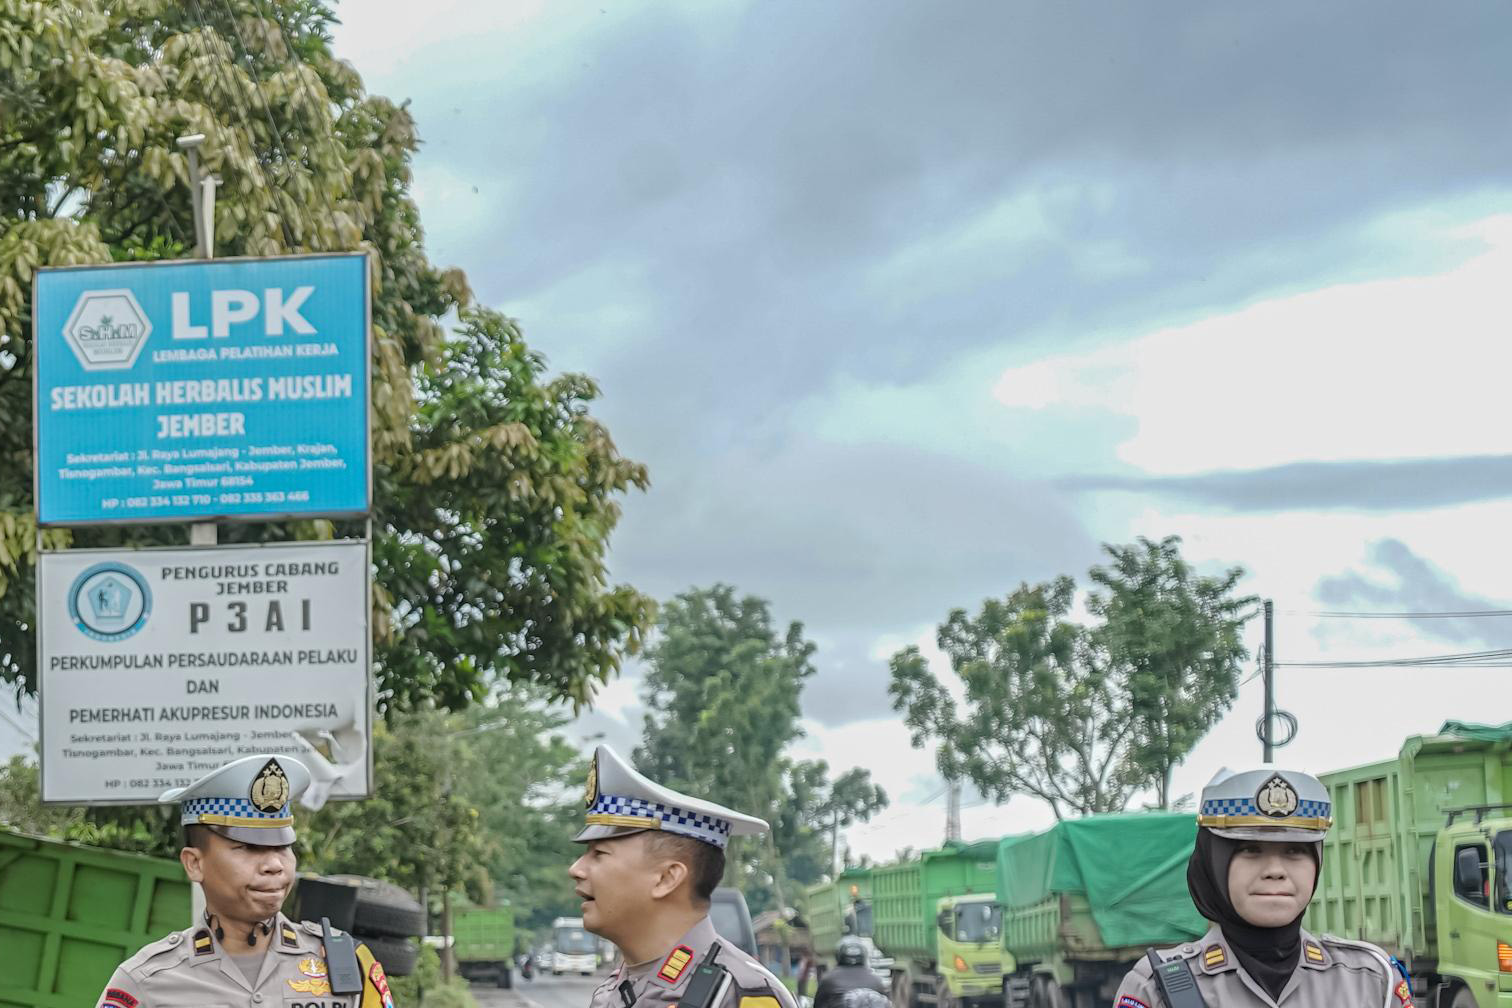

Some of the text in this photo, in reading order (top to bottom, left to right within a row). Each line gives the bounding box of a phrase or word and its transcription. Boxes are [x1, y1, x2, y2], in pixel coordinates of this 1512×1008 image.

[171, 286, 318, 340] LPK
[153, 348, 217, 363] LEMBAGA
[296, 342, 339, 357] KERJA
[51, 374, 353, 410] SEKOLAH HERBALIS MUSLIM
[157, 412, 246, 439] JEMBER
[66, 452, 130, 464] Sekretariat
[153, 478, 183, 490] Jawa
[185, 476, 219, 488] Timur
[101, 498, 119, 510] HP
[161, 561, 340, 581] PENGURUS CABANG
[216, 580, 289, 596] JEMBER
[50, 649, 358, 671] PERKUMPULAN PERSAUDARAAN PELAKU
[186, 680, 219, 694] DAN
[69, 703, 338, 724] PEMERHATI AKUPRESUR INDONESIA
[70, 733, 132, 744] Sekretariat
[184, 731, 241, 743] Lumajang
[155, 761, 185, 771] Jawa
[104, 779, 122, 788] HP
